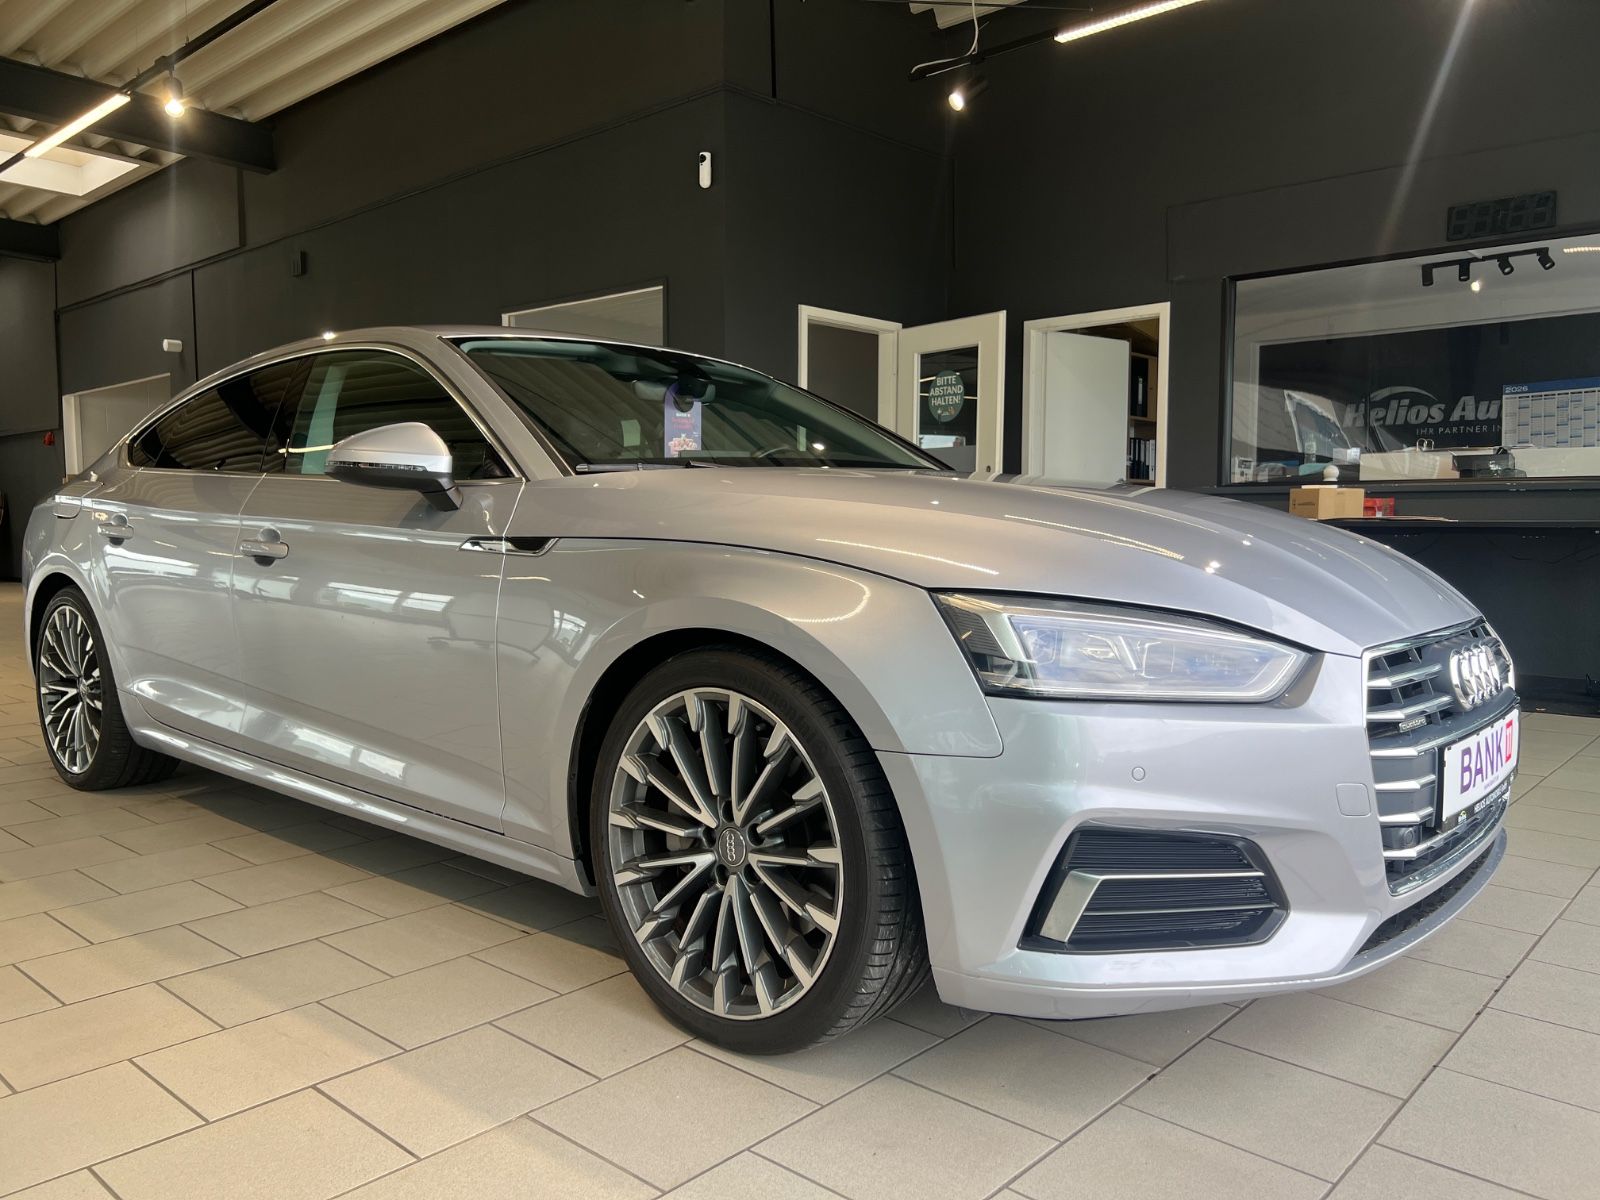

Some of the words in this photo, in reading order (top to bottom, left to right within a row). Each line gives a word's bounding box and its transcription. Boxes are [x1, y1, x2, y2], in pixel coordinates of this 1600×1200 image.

[936, 375, 957, 386] BITTE
[930, 384, 964, 397] ABSTAND
[931, 395, 961, 406] HALTEN!
[1343, 399, 1446, 428] Helios
[1416, 428, 1434, 436] IHR
[1438, 425, 1488, 435] PARTNER
[1401, 717, 1426, 731] quattro
